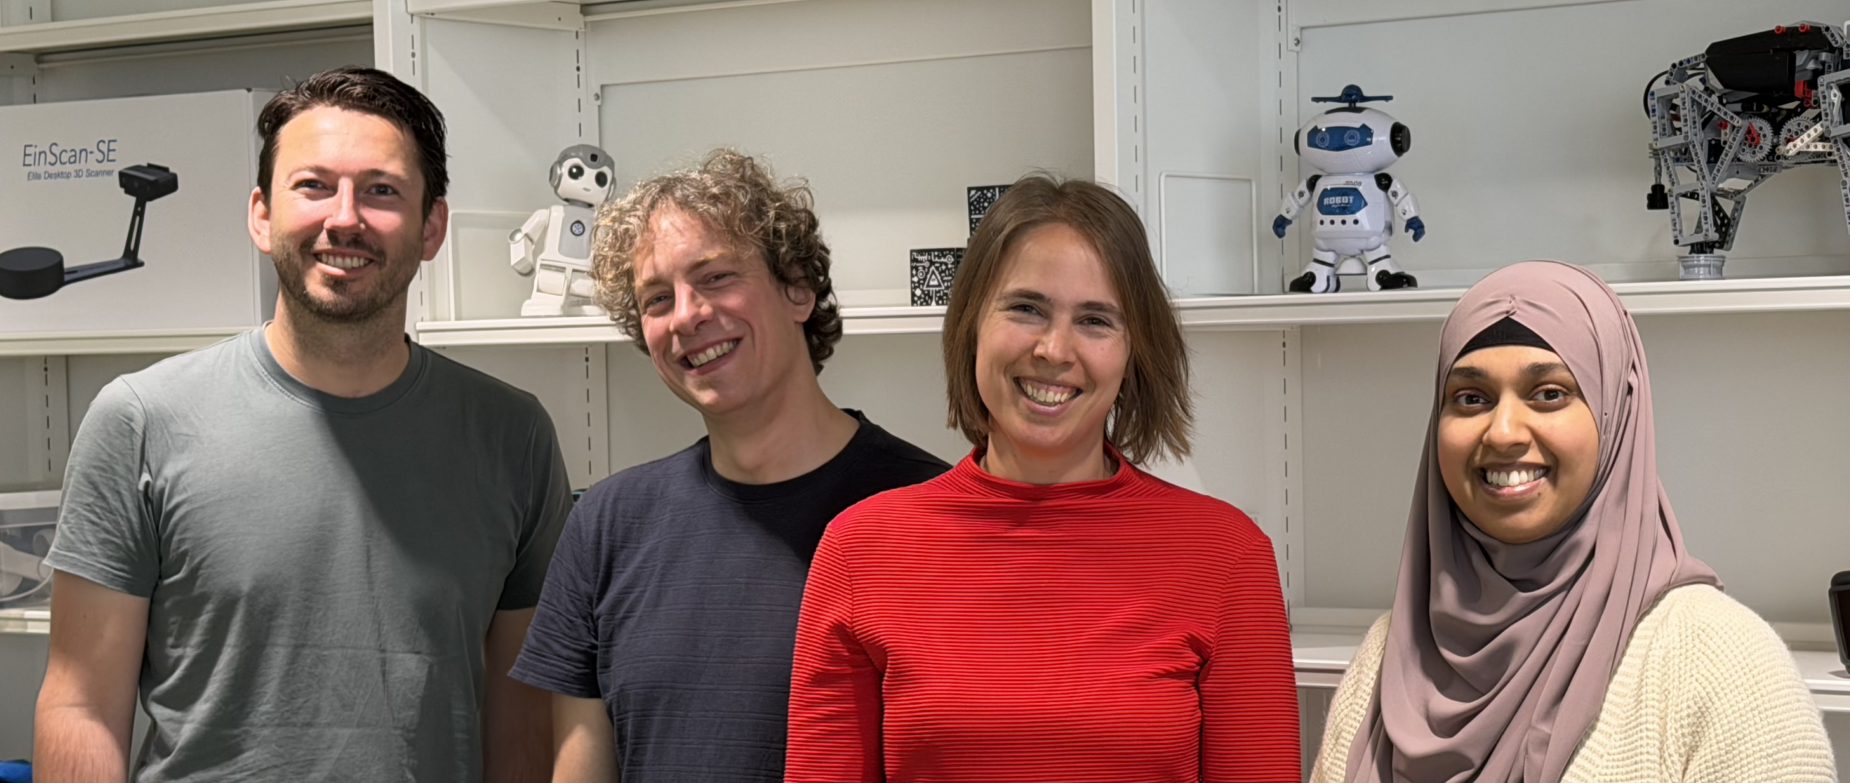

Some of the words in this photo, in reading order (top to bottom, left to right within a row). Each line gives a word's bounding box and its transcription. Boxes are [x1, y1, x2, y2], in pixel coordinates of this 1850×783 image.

[22, 139, 118, 167] EinScan-SE
[43, 170, 72, 180] Desktop
[73, 168, 84, 178] 3D
[85, 168, 115, 178] Scanner
[1323, 196, 1354, 205] ROBOT
